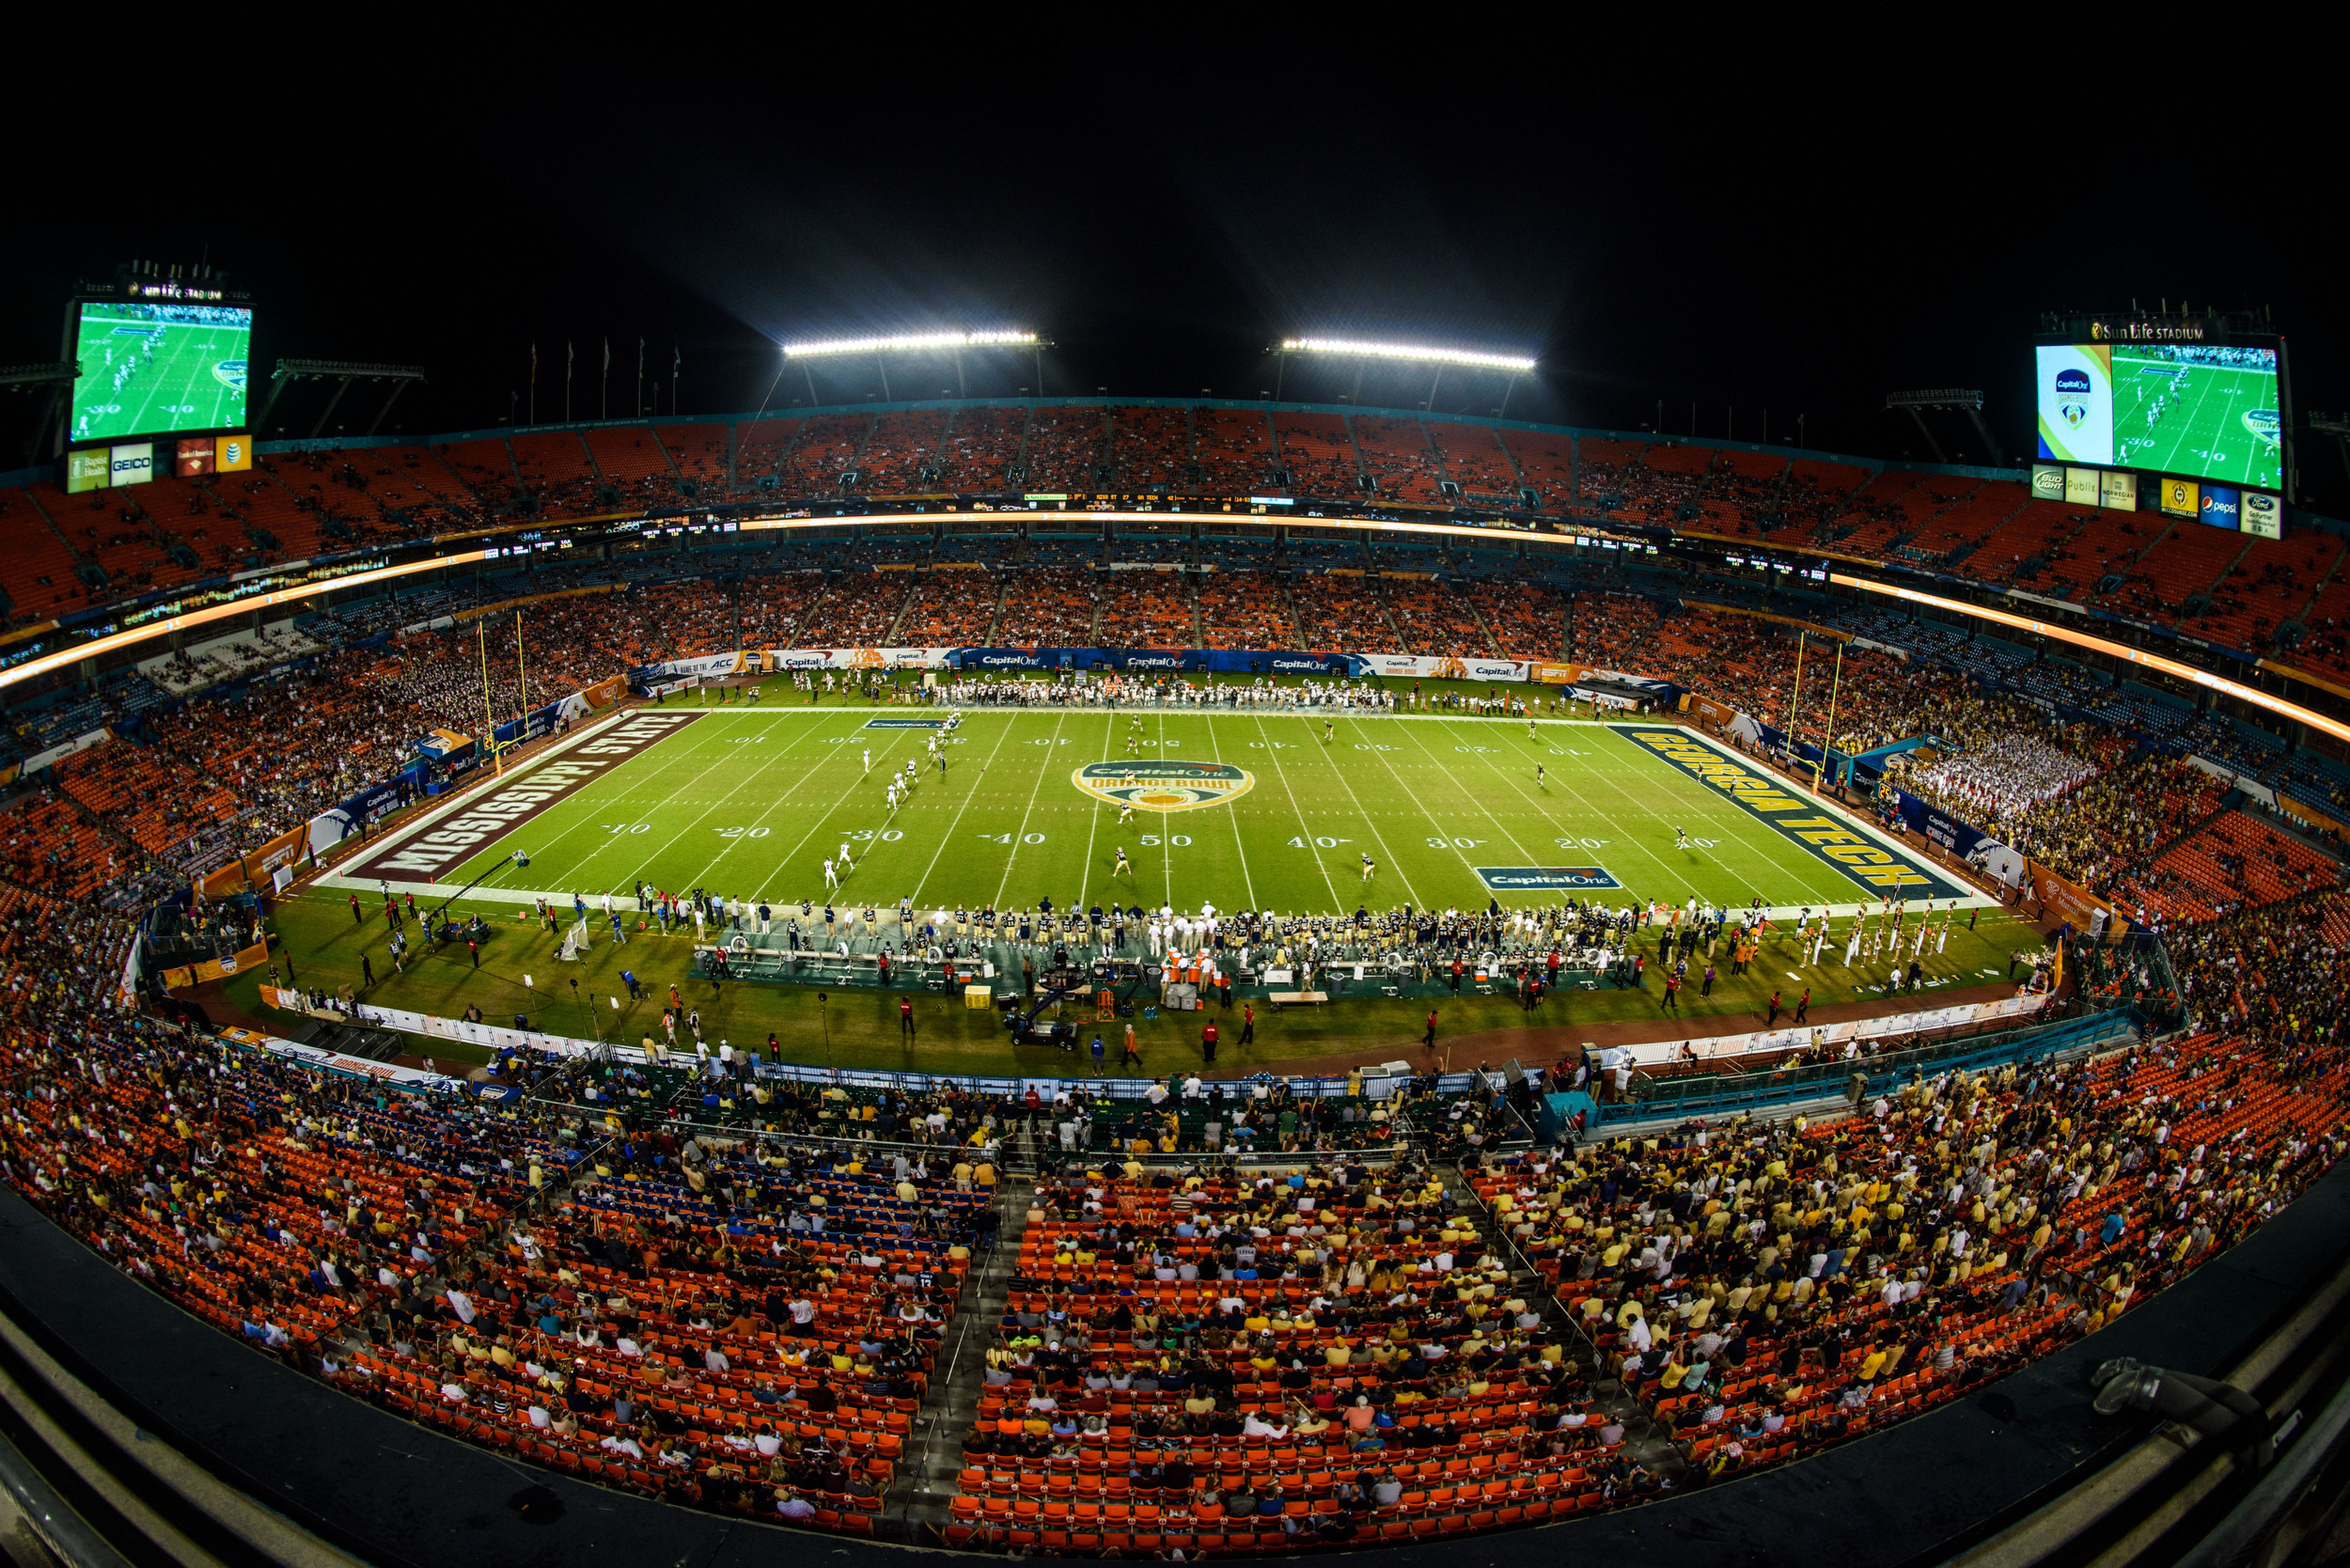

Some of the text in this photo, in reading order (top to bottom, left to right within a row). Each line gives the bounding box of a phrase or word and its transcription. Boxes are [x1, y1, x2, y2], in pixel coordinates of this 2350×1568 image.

[184, 288, 222, 300] STADIUM
[2104, 322, 2203, 339] Sun Life STADIUM
[2128, 438, 2155, 447] 30
[2198, 449, 2226, 461] 40
[85, 455, 107, 467] Baptist
[113, 457, 150, 471] GEICO
[85, 466, 107, 476] Health
[2042, 474, 2062, 482] BUD
[2037, 480, 2063, 489] LIGHT
[2068, 479, 2096, 493] Publix
[2102, 490, 2134, 498] NORWEGIAN
[2213, 502, 2237, 514] pepsi
[2251, 496, 2269, 510] Ford
[2256, 512, 2273, 521] Further
[711, 658, 733, 669] ACC
[786, 658, 836, 667] CapitalOne
[983, 656, 1041, 666] CapitalOne
[1128, 657, 1186, 667] CapitalOne
[1273, 660, 1329, 670] CapitalOne
[1476, 666, 1526, 677] CapitalOne
[1542, 667, 1567, 677] ESPN
[600, 684, 619, 699] VIZIO
[1700, 703, 1717, 718] ESPN
[1090, 767, 1230, 778] CapitalOne
[1175, 779, 1235, 790] BOWL
[375, 715, 689, 872] MISSISSIPPI STATE
[1880, 786, 1889, 797] 25
[367, 790, 397, 807] CapitalOne
[1632, 731, 1933, 886] GEORGIA TECH
[605, 823, 651, 835] 10
[1928, 814, 1959, 837] CapitalOne
[720, 827, 771, 838] 20
[852, 829, 904, 840] 30
[993, 832, 1047, 844] 40
[1140, 835, 1193, 846] 50
[1287, 837, 1340, 848] 40
[1425, 837, 1476, 848] 30
[1555, 838, 1602, 848] 20
[1491, 875, 1609, 886] CapitalOne
[2060, 887, 2094, 914] Northweste
[2058, 897, 2080, 917] Mutual
[284, 1047, 397, 1079] CapitalOne ORANGE BOWL
